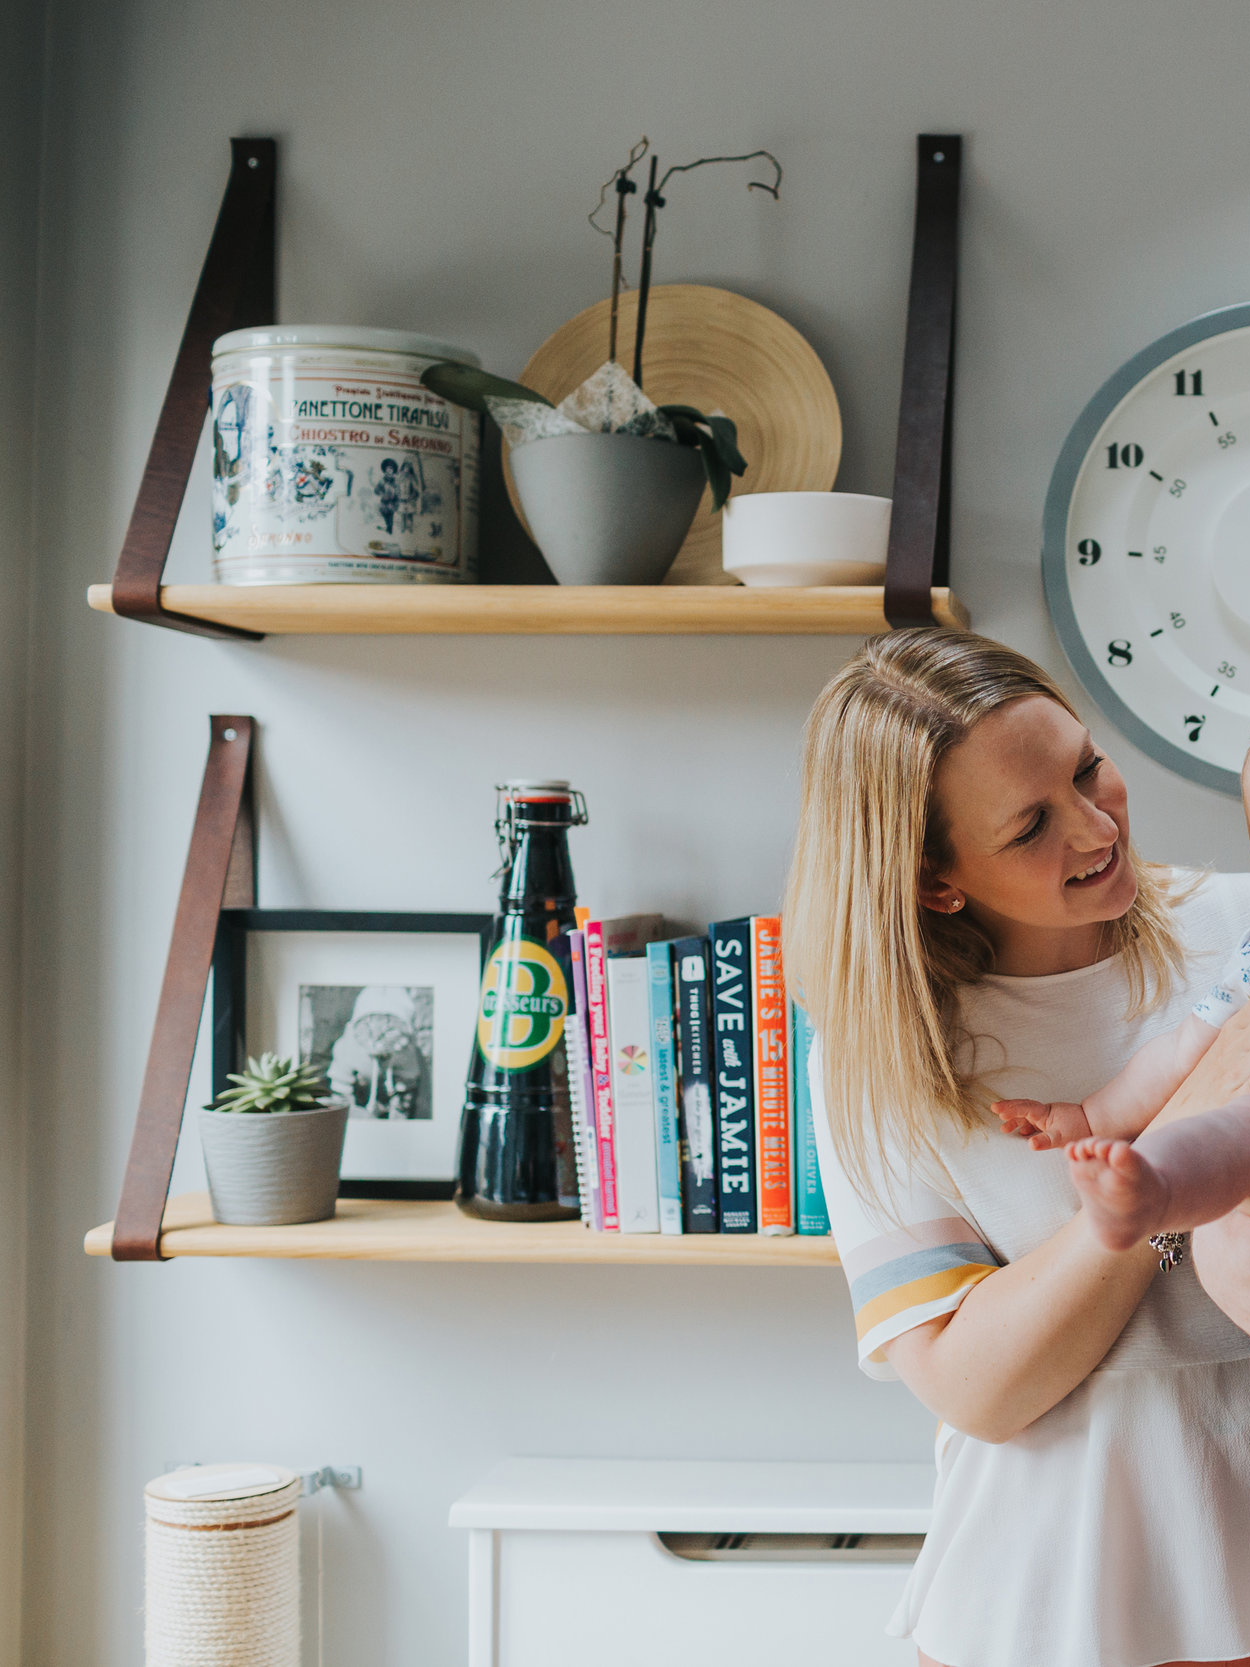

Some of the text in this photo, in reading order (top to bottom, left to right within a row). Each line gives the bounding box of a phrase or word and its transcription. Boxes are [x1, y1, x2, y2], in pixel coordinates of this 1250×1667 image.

[1173, 369, 1204, 396] 11
[290, 425, 370, 444] CHIOSTRO
[1217, 432, 1237, 450] 55
[1106, 442, 1144, 469] 10
[1169, 479, 1187, 499] 50
[1077, 539, 1101, 566] 9
[1153, 545, 1167, 564] 45
[1169, 610, 1187, 630] 40
[1108, 639, 1133, 667] 8
[1217, 660, 1237, 679] 35
[1184, 714, 1206, 743] 7
[715, 939, 744, 1031] SAVE
[758, 929, 782, 1020] JAMIE'S
[590, 1003, 604, 1036] your
[593, 1037, 608, 1073] Baby
[722, 1038, 742, 1068] with
[758, 1028, 783, 1062] 15
[598, 1087, 613, 1139] Toddler
[762, 1067, 785, 1129] MINUTE
[658, 1096, 672, 1144] greatest
[719, 1072, 749, 1193] JAMIE
[763, 1136, 786, 1190] MEALS
[806, 1147, 817, 1194] OLIVER
